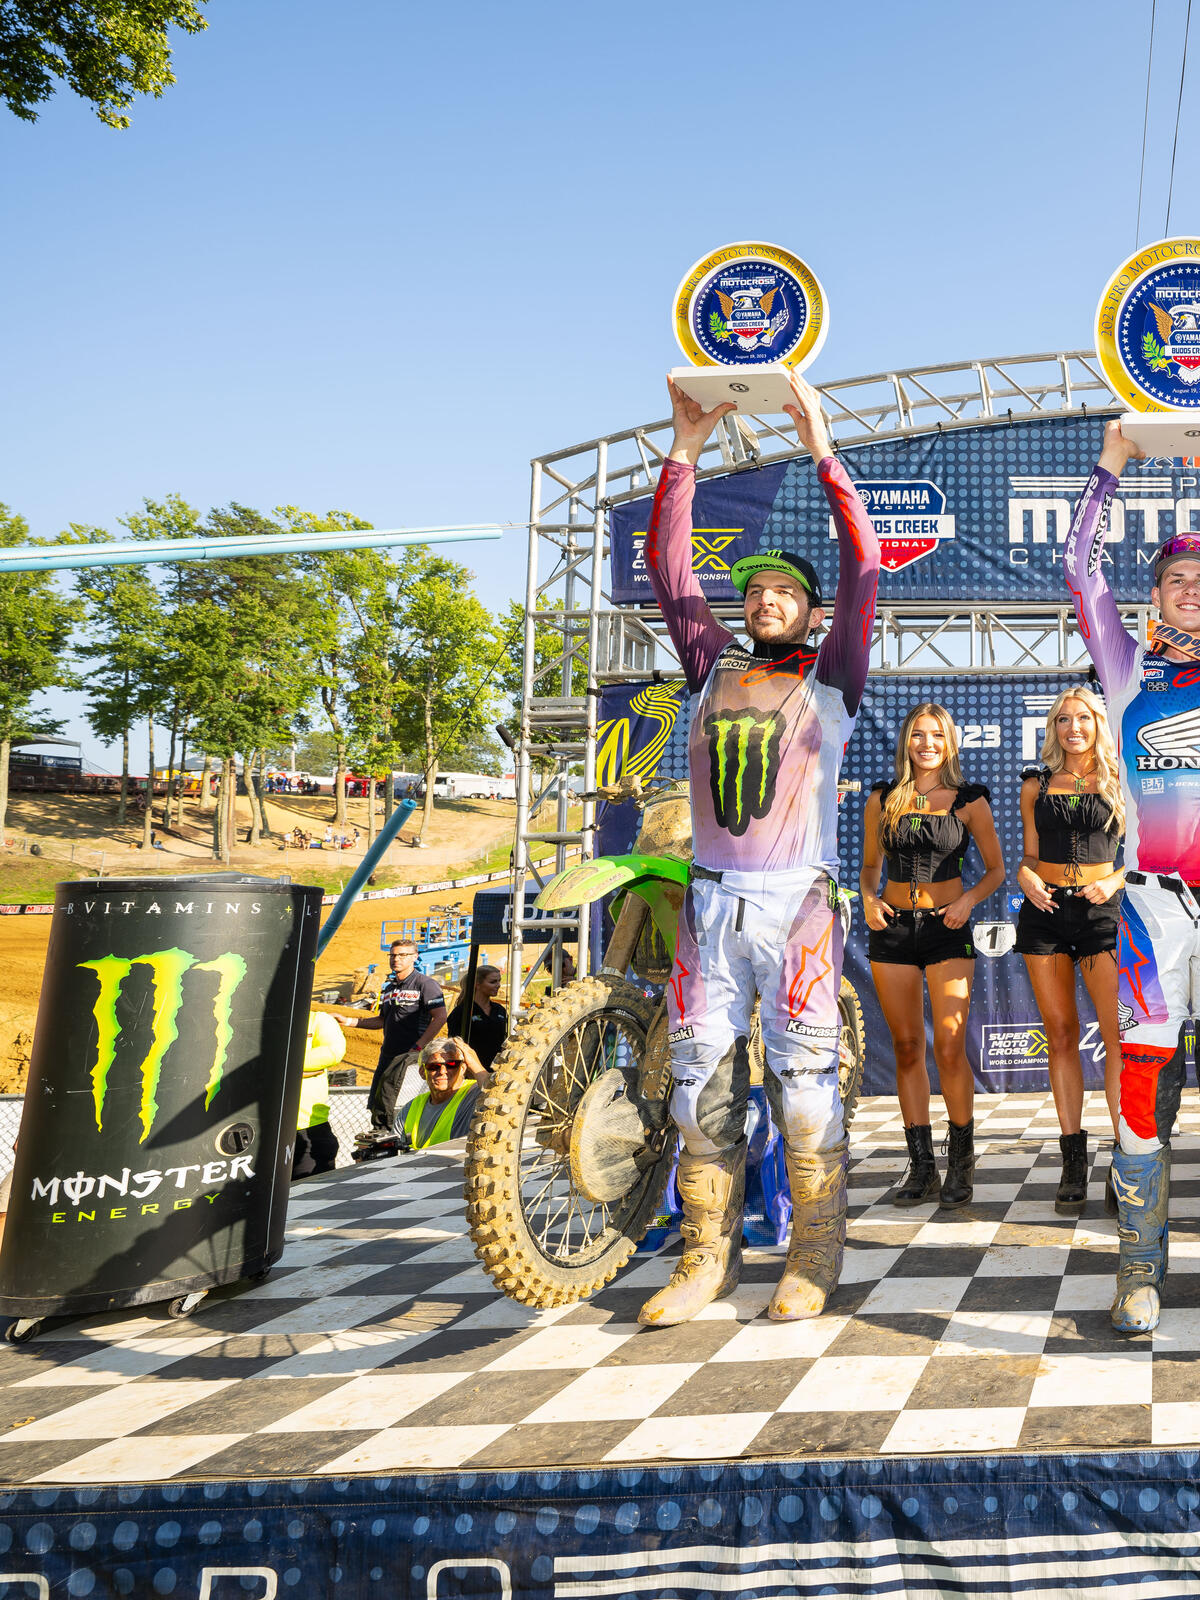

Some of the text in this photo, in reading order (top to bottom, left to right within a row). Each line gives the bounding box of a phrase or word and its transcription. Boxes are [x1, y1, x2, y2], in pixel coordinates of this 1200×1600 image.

[677, 246, 821, 333] 2023 PRO MOTOCROSS CHAMPIONSHIP
[720, 278, 776, 287] MOTOCROSS
[1101, 306, 1116, 336] 2023
[1109, 272, 1130, 302] PRO
[872, 490, 930, 504] YAMAHA
[895, 520, 939, 533] CREEK
[1064, 474, 1099, 577] alpinestars
[1088, 491, 1112, 577] HONDA
[737, 562, 793, 574] Kawasaki
[84, 901, 262, 915] VITAMINS
[991, 1040, 1028, 1048] MOTO
[32, 1155, 256, 1205] MONSTER
[52, 1193, 220, 1223] ENERGY
